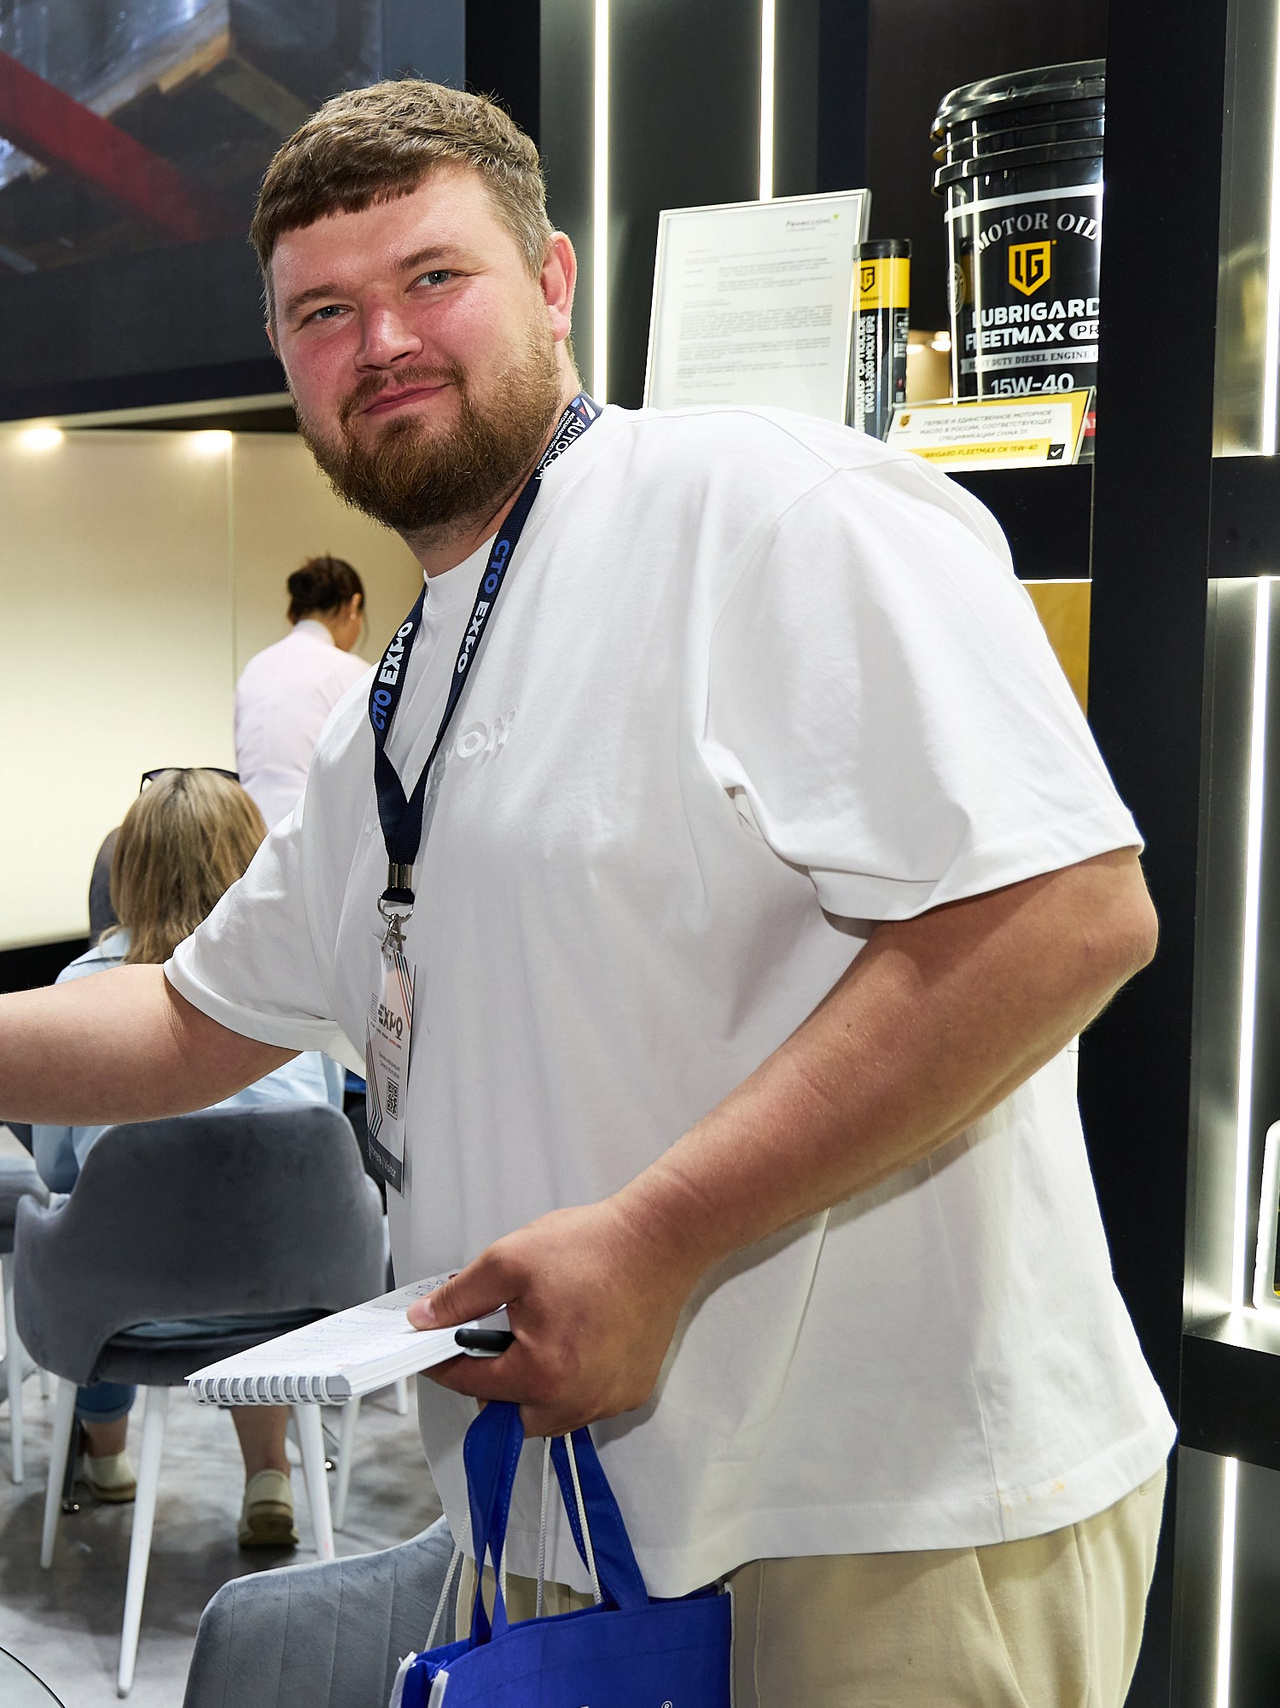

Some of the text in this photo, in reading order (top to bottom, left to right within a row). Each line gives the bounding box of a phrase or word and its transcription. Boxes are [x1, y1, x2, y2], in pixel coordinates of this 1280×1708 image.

[973, 213, 1098, 254] MOTOR OIL
[972, 298, 1100, 328] LUBRIGARD
[966, 322, 1065, 350] FLEETMAX
[1015, 353, 1048, 365] DIESEL
[1050, 350, 1090, 361] ENGINE
[990, 372, 1075, 398] 15W-40
[457, 539, 510, 674] CTO EXPO
[372, 621, 414, 731] CTO EXPO
